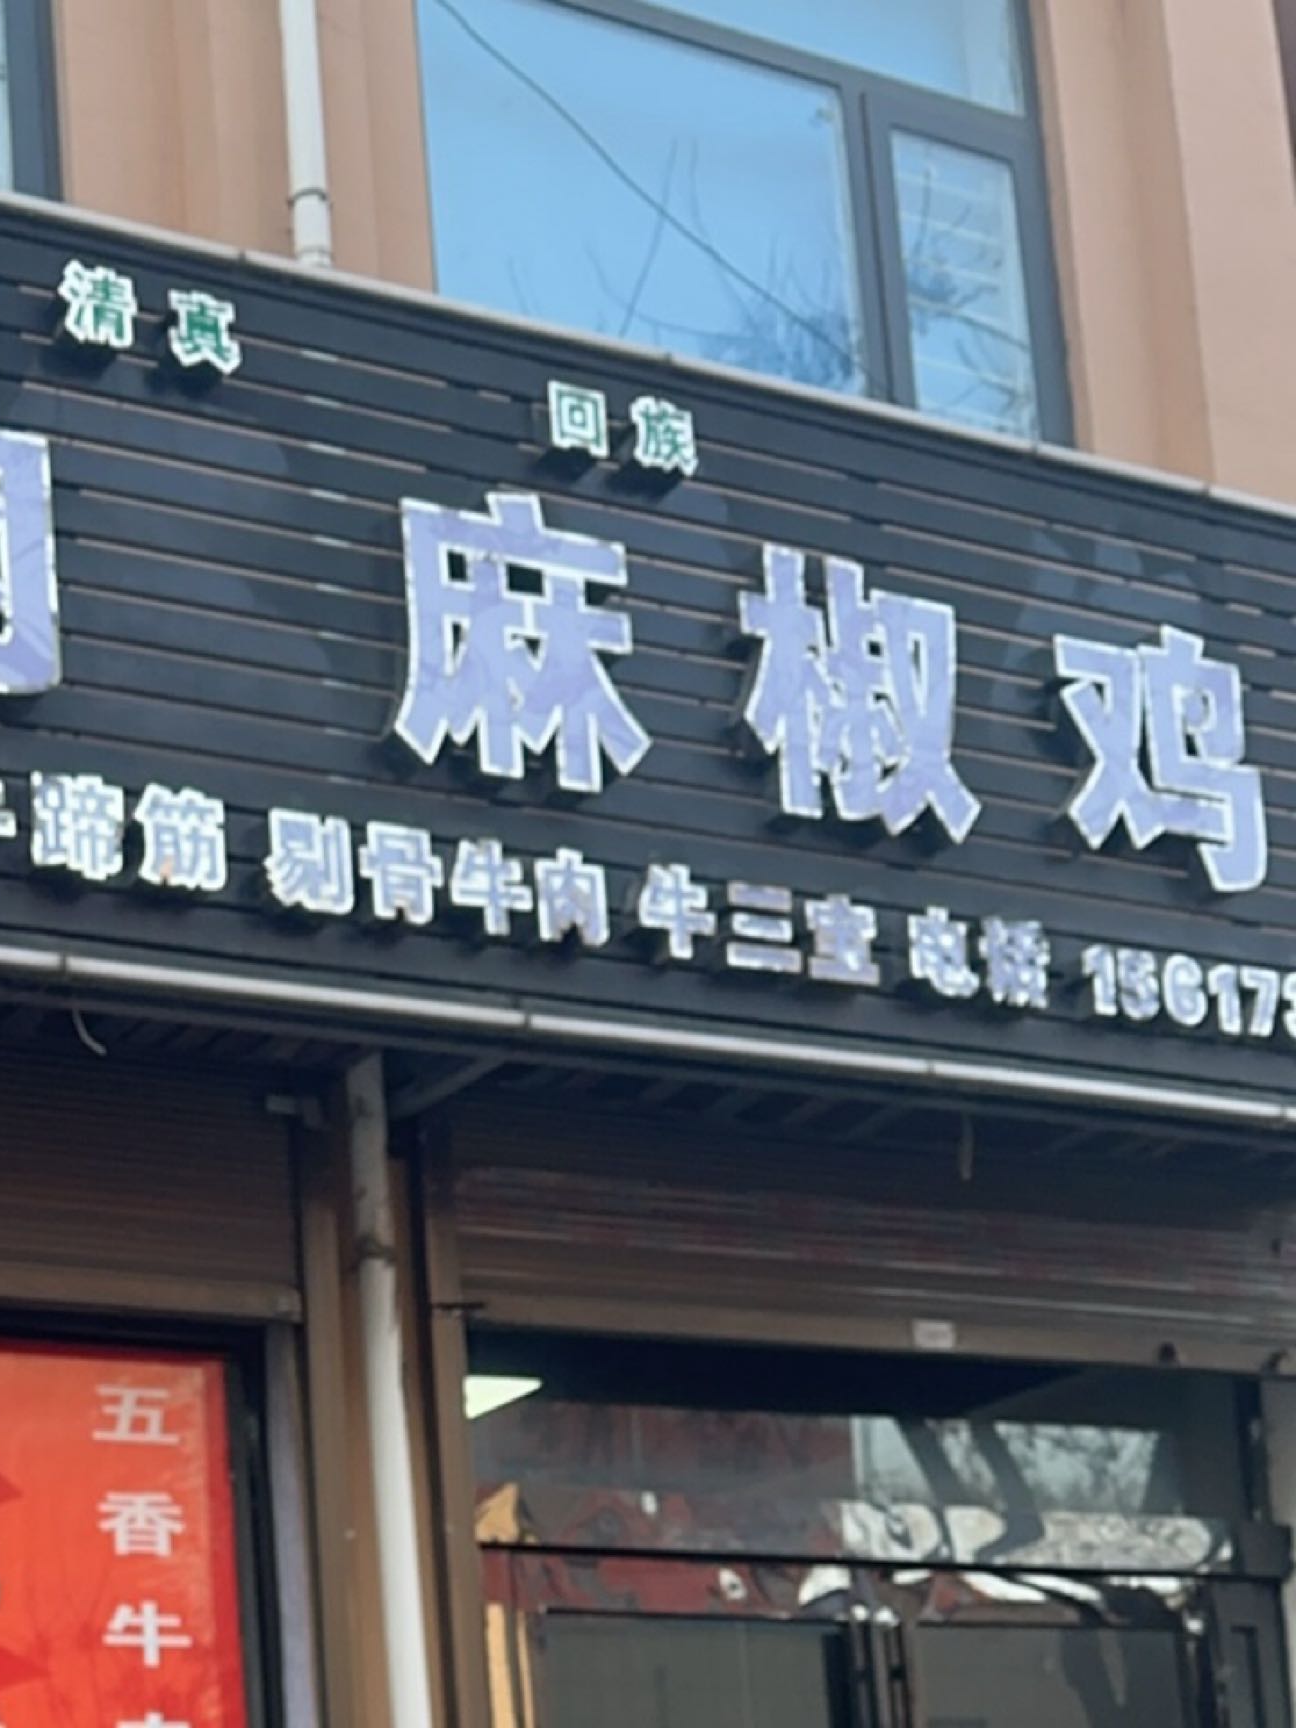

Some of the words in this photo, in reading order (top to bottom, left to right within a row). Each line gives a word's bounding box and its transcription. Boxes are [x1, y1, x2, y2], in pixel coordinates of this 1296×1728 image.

[59, 258, 241, 374] 清真
[547, 380, 698, 477] 回族
[394, 491, 1269, 894] 麻椒鸡
[263, 807, 610, 948] 剔骨牛肉
